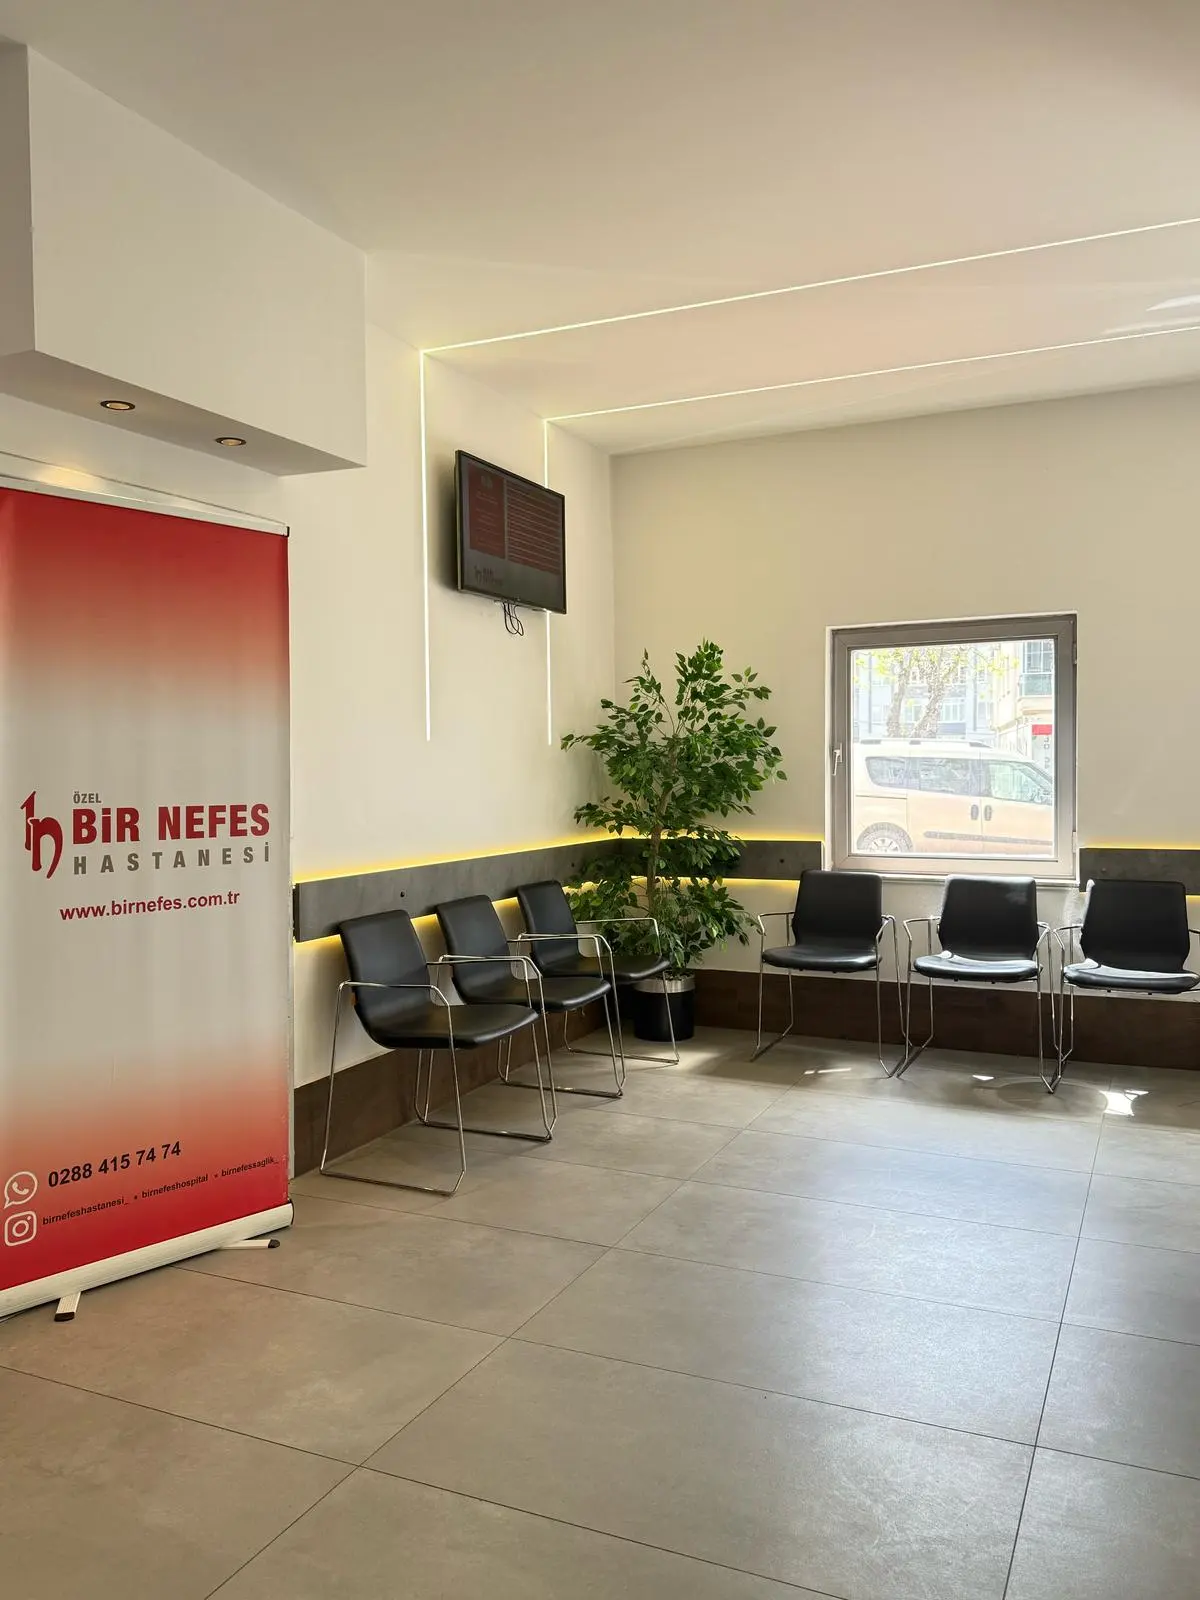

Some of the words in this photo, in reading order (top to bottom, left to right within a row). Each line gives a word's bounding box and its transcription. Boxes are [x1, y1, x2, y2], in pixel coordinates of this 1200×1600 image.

[73, 790, 102, 804] ÖZEL
[158, 803, 270, 841] NEFES
[73, 841, 269, 875] HASTANESİ
[60, 890, 240, 921] www.birnefes.com.tr
[48, 1163, 92, 1188] 0288
[98, 1153, 130, 1174] 415
[136, 1147, 156, 1166] 74
[162, 1141, 181, 1159] 74
[141, 1174, 209, 1199] birnefeshospital
